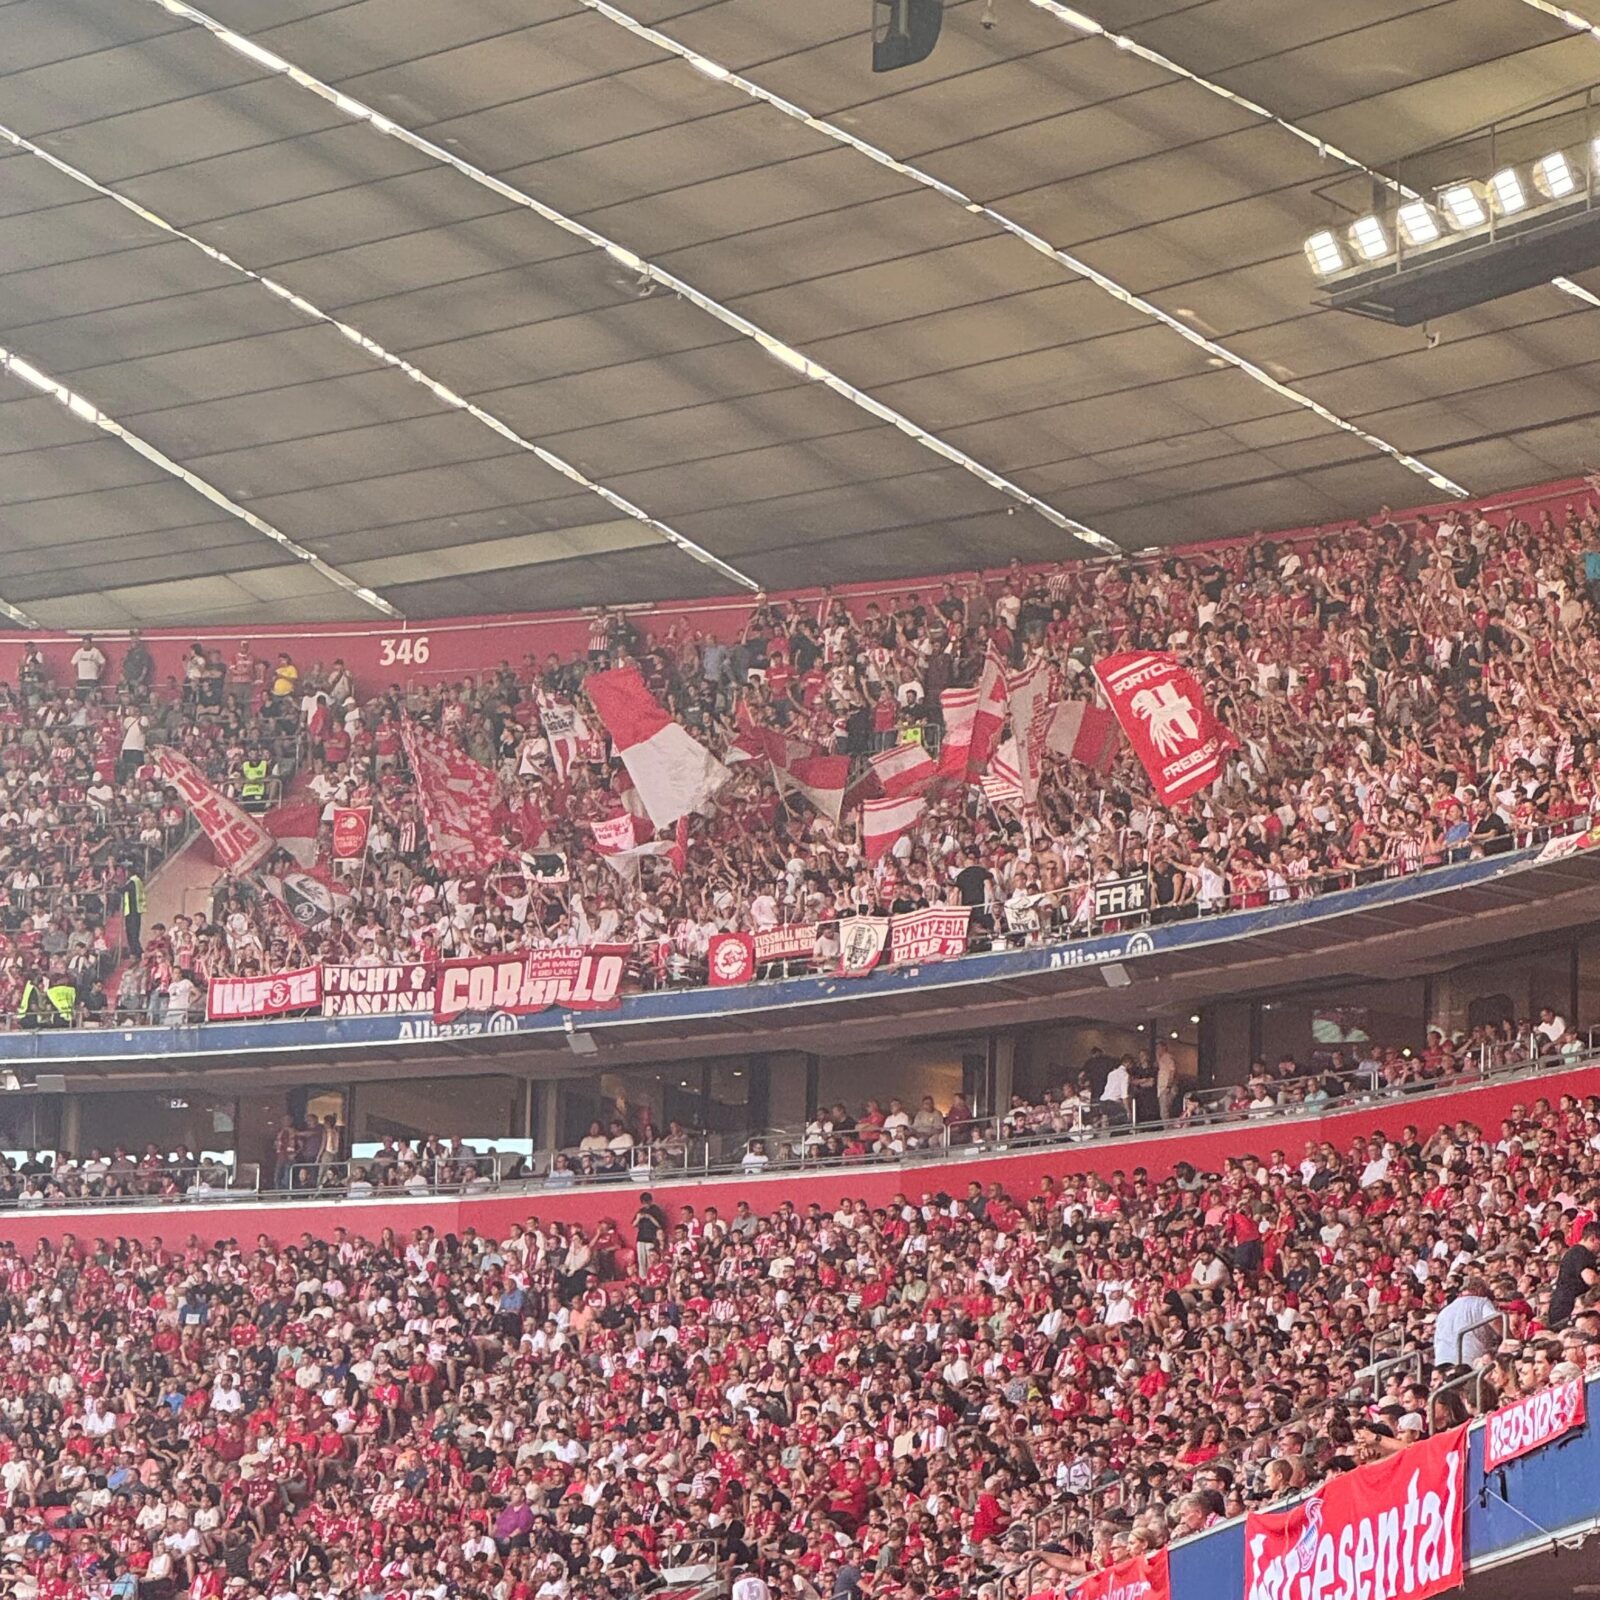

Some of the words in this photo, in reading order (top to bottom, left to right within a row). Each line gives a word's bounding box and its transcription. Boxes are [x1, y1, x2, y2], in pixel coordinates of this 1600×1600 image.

[380, 637, 429, 665] 346
[755, 929, 794, 947] FUSSBALL
[945, 939, 963, 955] 79
[533, 949, 582, 961] KHALID
[1050, 948, 1121, 968] Allianz
[324, 967, 403, 992] FIGHT
[398, 1020, 482, 1040] Allianz
